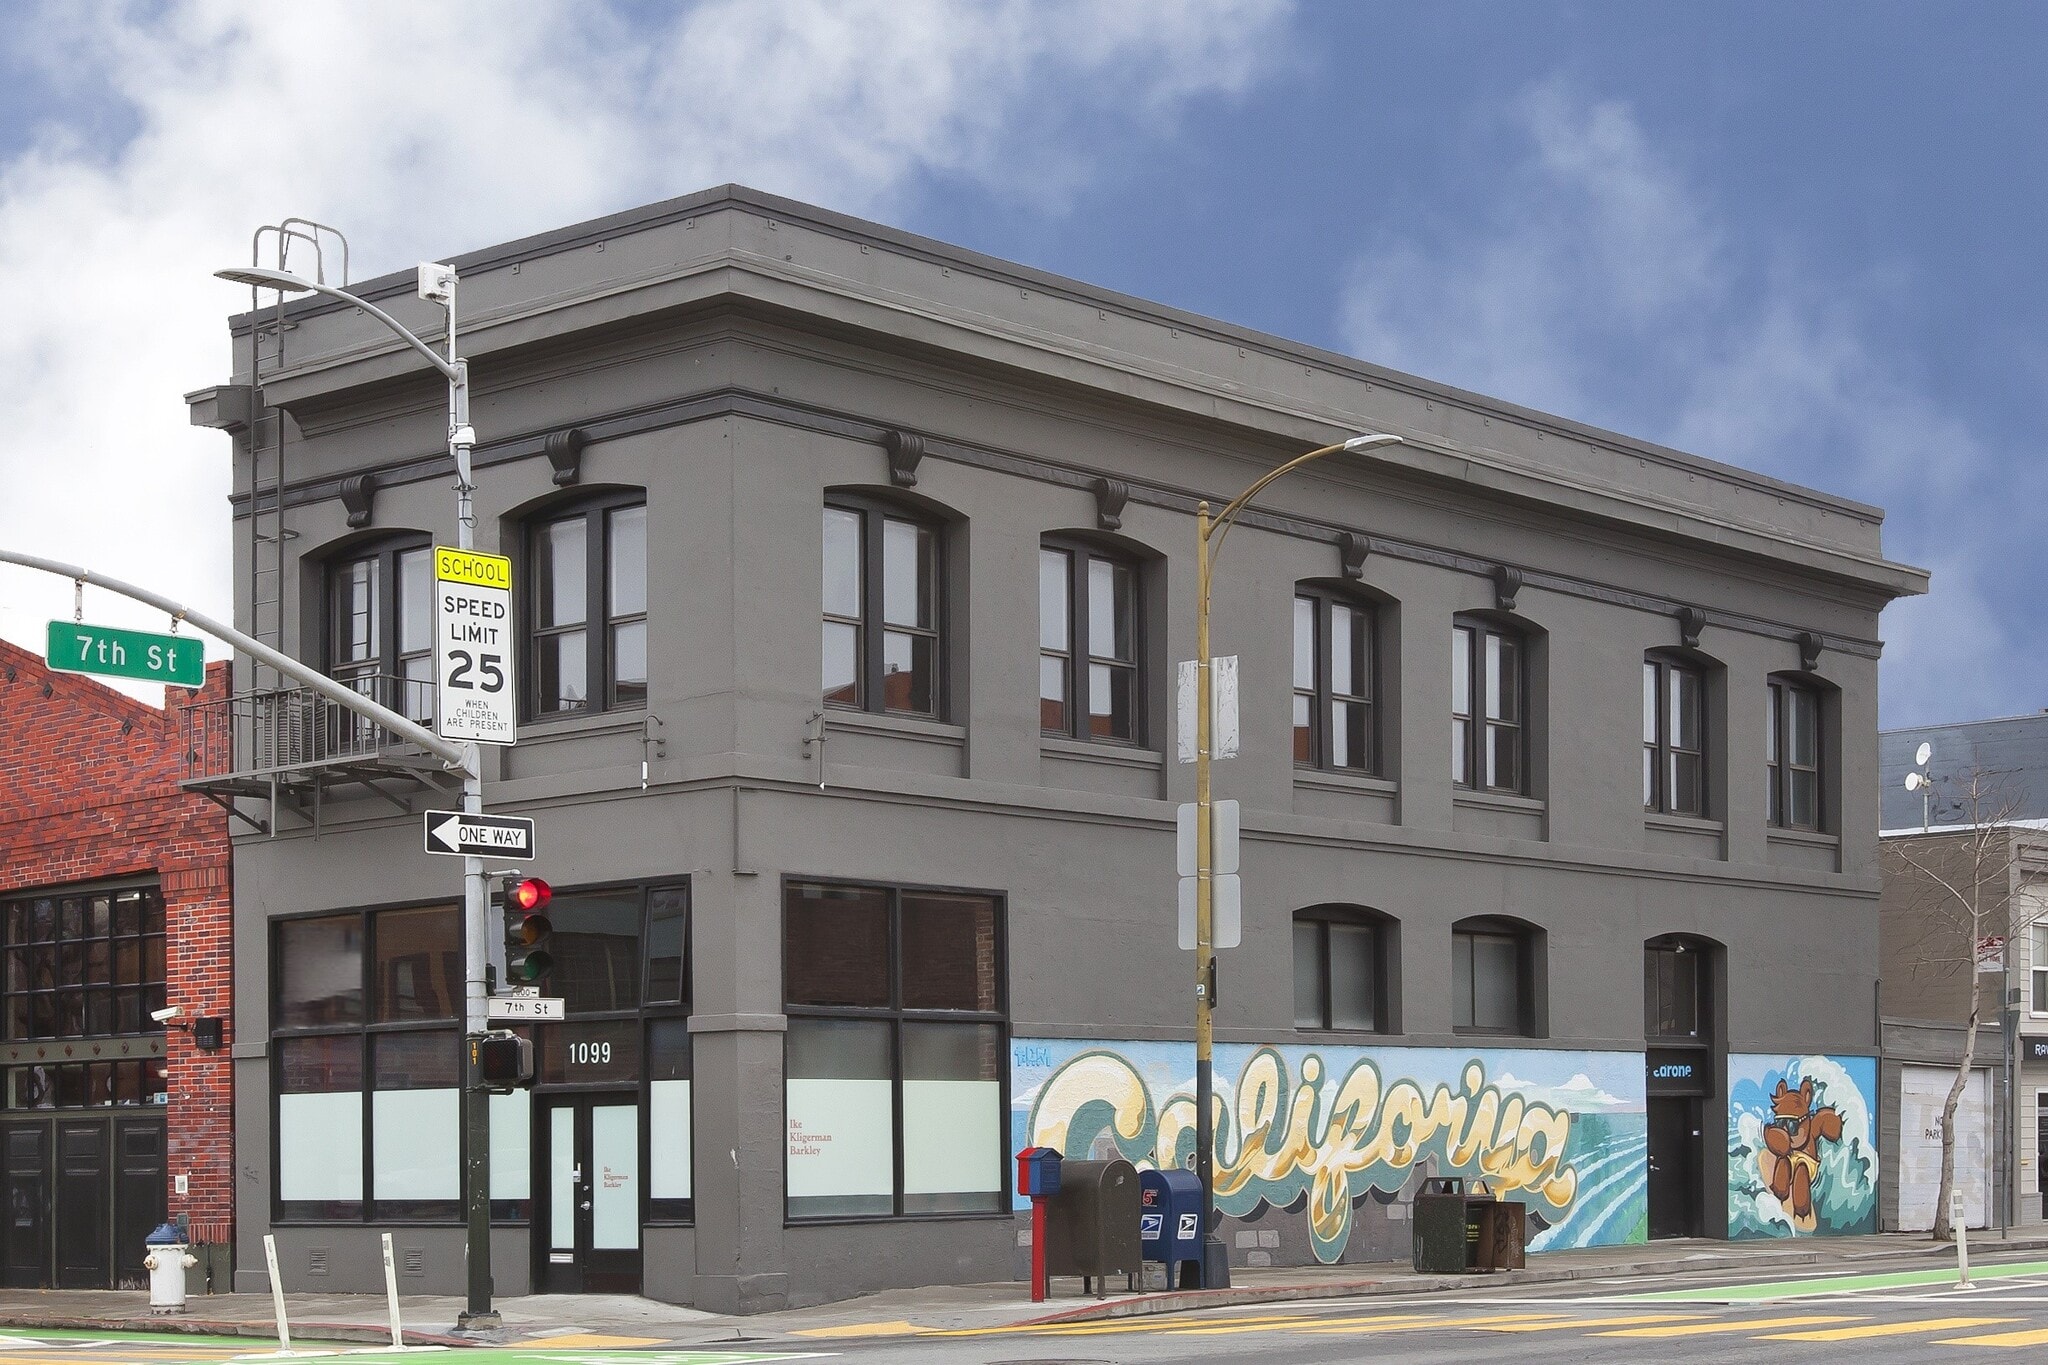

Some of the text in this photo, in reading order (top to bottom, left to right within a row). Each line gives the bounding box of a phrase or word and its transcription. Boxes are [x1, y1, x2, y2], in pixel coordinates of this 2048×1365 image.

[442, 556, 506, 582] SCHOOL
[444, 595, 505, 619] SPEED
[451, 623, 499, 645] LIMIT
[76, 635, 177, 672] 7th St
[448, 649, 504, 693] 25
[465, 699, 489, 709] WHEN
[456, 708, 499, 720] CHILDREN
[447, 717, 508, 731] ARE PRESENT
[459, 826, 522, 846] ONE WAY
[505, 1002, 548, 1015] 7th St
[568, 1042, 611, 1064] 1099
[790, 1119, 803, 1129] Ike
[790, 1132, 832, 1144] Kligerman
[790, 1145, 821, 1157] Barkley
